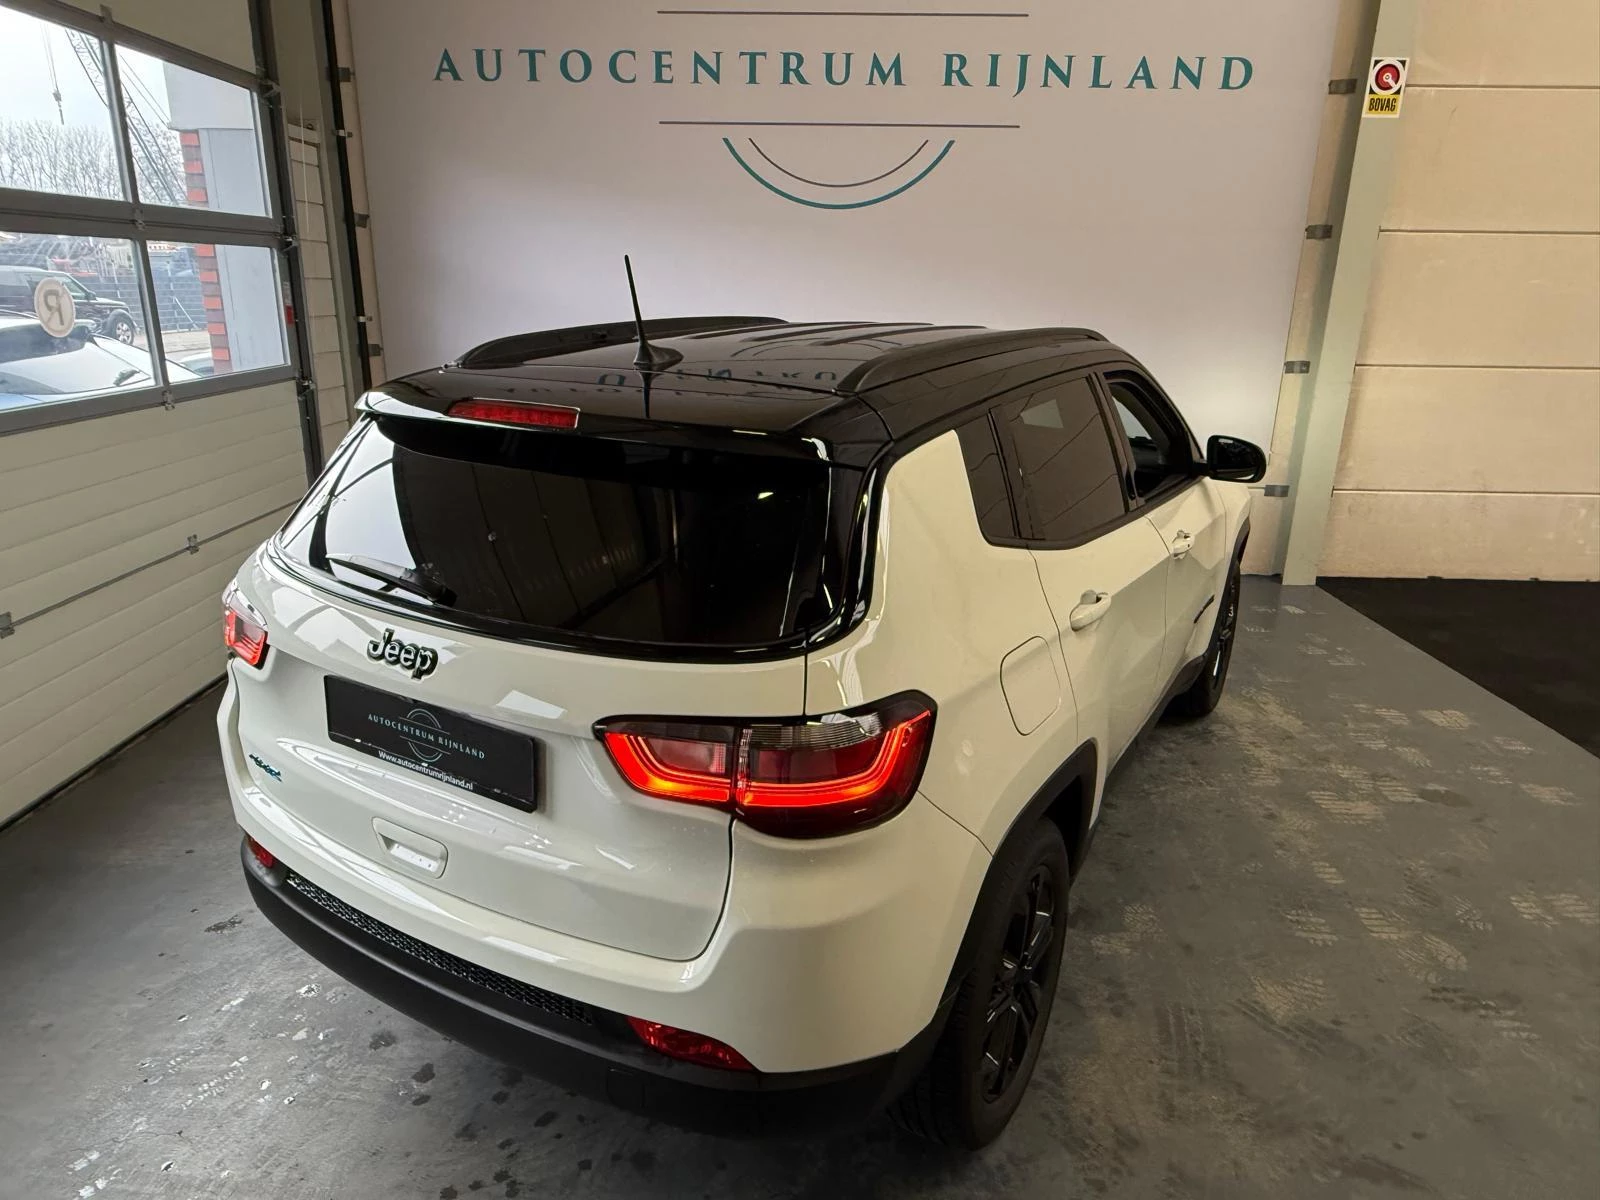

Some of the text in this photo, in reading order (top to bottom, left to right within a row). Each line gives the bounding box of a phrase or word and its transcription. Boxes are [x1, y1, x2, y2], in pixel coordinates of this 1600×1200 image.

[433, 47, 1253, 98] AUTOCENTRUM RIJNLAND
[1368, 97, 1397, 112] BOVAG
[367, 627, 438, 680] Jeep
[367, 713, 486, 760] AUTOCENTRUM RIJNLAND
